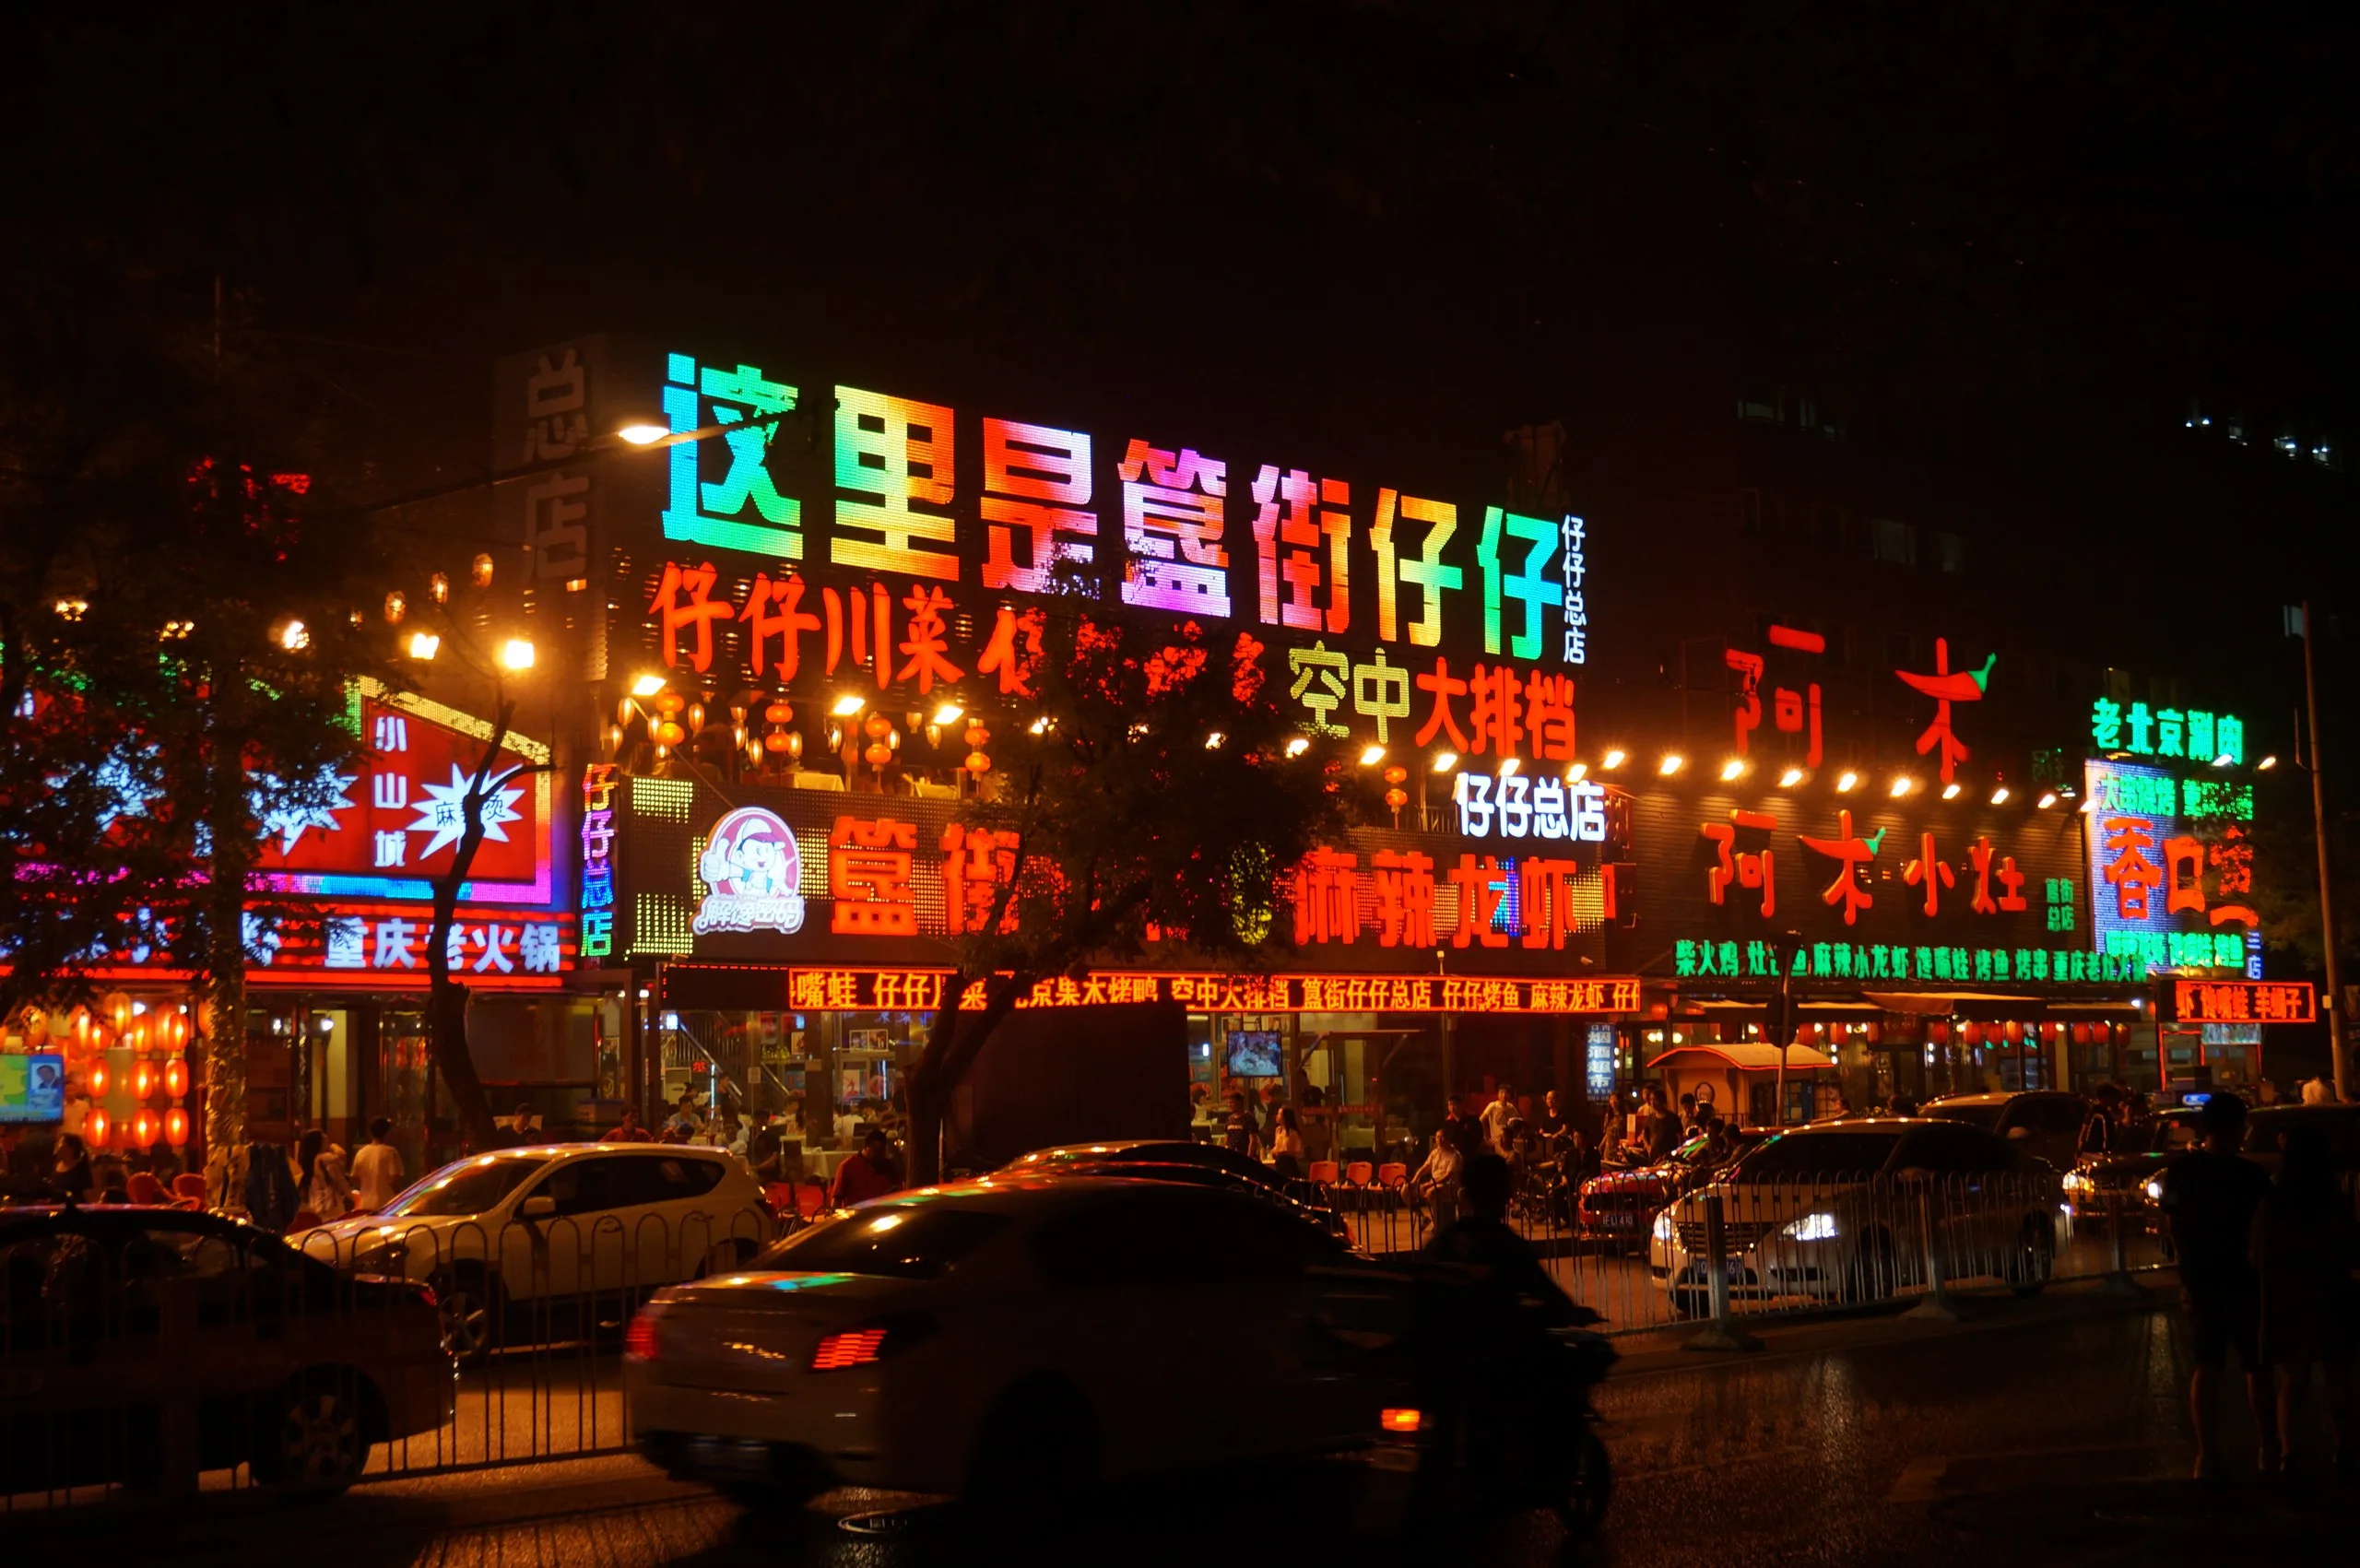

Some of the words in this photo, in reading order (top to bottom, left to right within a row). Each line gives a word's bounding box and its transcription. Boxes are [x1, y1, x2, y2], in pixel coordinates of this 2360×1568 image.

[1562, 514, 1587, 665] 仔仔总店
[1289, 640, 1575, 761] 空中大排档
[1726, 625, 1996, 783] 阿木
[374, 716, 407, 867] 小山城
[435, 793, 506, 828] 麻烫
[1457, 772, 1606, 842] 仔仔总店
[581, 763, 620, 957] 仔仔总店
[1294, 845, 1575, 950] 麻辣龙虾
[1700, 808, 2027, 925] 阿木小灶
[1530, 982, 1604, 1011] 麻辣龙虾
